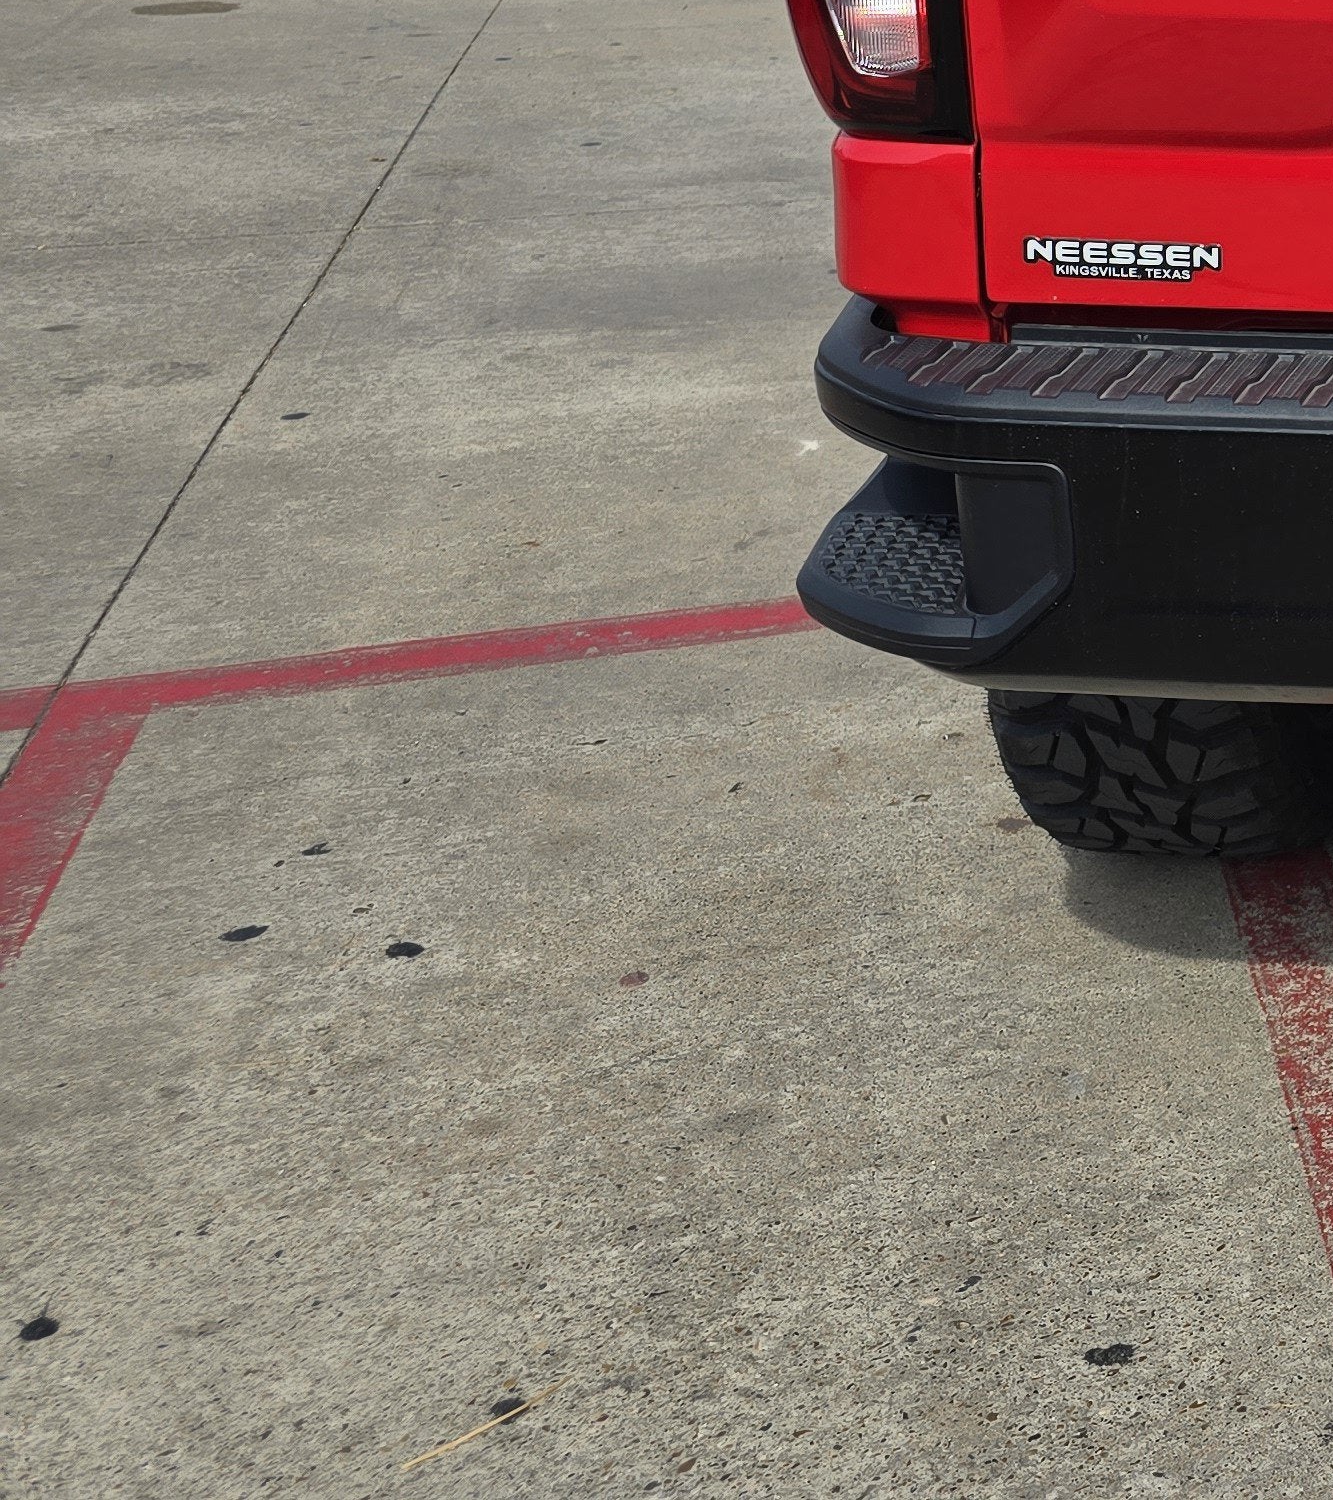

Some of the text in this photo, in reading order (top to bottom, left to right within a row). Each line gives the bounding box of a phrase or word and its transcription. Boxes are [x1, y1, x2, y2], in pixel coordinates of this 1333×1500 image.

[1026, 239, 1219, 268] NEESSEN
[1055, 264, 1191, 280] KINGSVILLE, TEXAS
